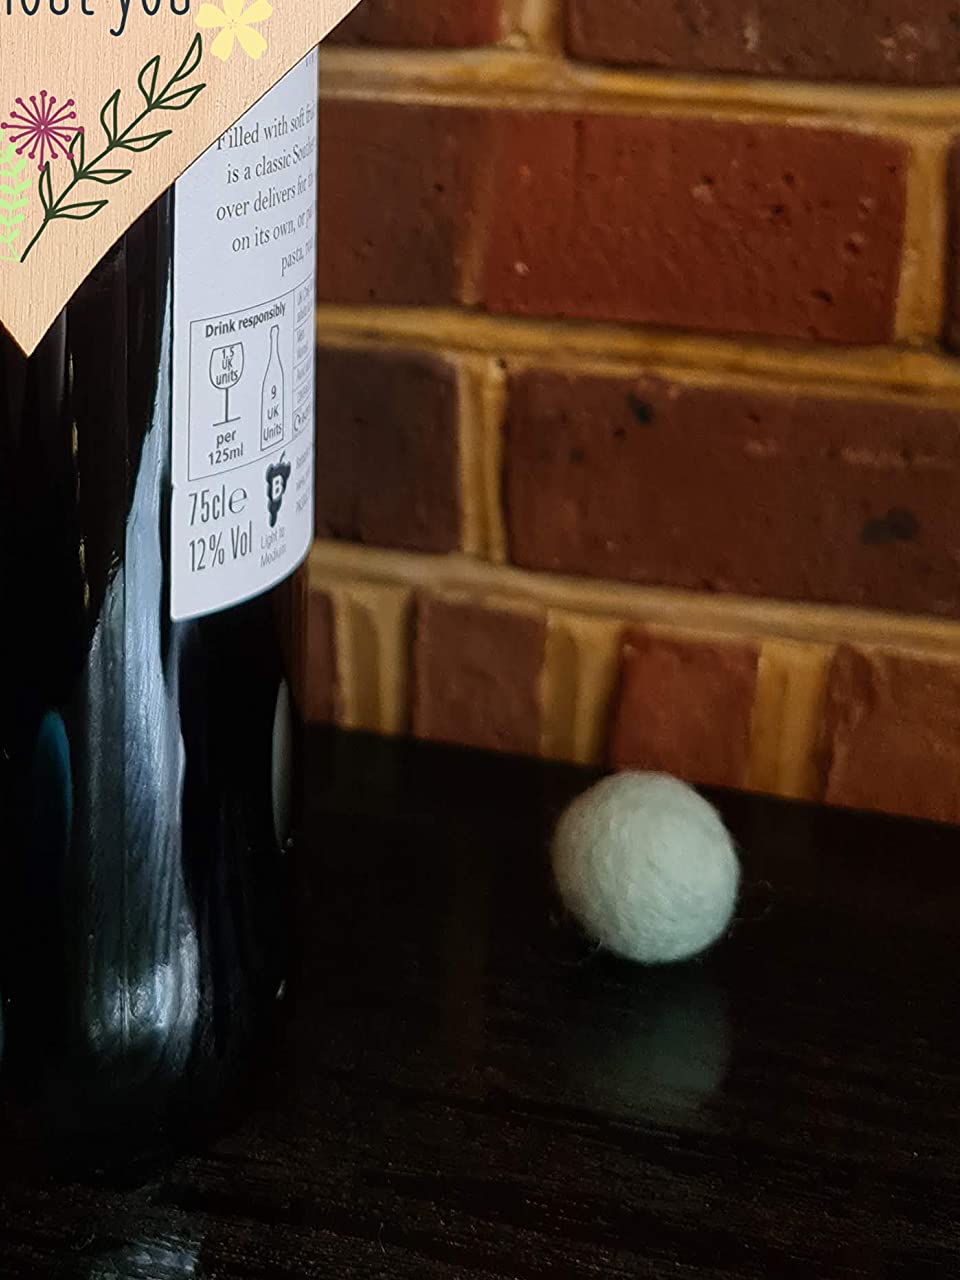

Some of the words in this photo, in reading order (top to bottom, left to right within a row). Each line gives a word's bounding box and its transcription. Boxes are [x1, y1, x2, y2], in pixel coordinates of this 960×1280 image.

[216, 122, 259, 151] Filled
[263, 115, 288, 140] with
[227, 163, 239, 184] is
[243, 166, 252, 180] a
[255, 150, 291, 177] classic
[216, 201, 250, 221] over
[253, 184, 296, 214] delivers
[232, 235, 250, 253] on
[254, 225, 270, 247] its
[272, 220, 296, 241] own,
[205, 318, 237, 339] Drink
[239, 301, 287, 331] responsibly
[221, 346, 235, 359] 1.5
[221, 356, 233, 371] UK
[216, 368, 238, 386] units
[270, 385, 277, 400] 9
[267, 405, 279, 421] UK
[216, 431, 237, 451] per
[263, 423, 282, 442] Units
[208, 443, 244, 466] 125ml
[271, 475, 283, 500] B
[188, 484, 226, 526] 75cl
[189, 531, 225, 572] 12%
[231, 521, 252, 560] Vol
